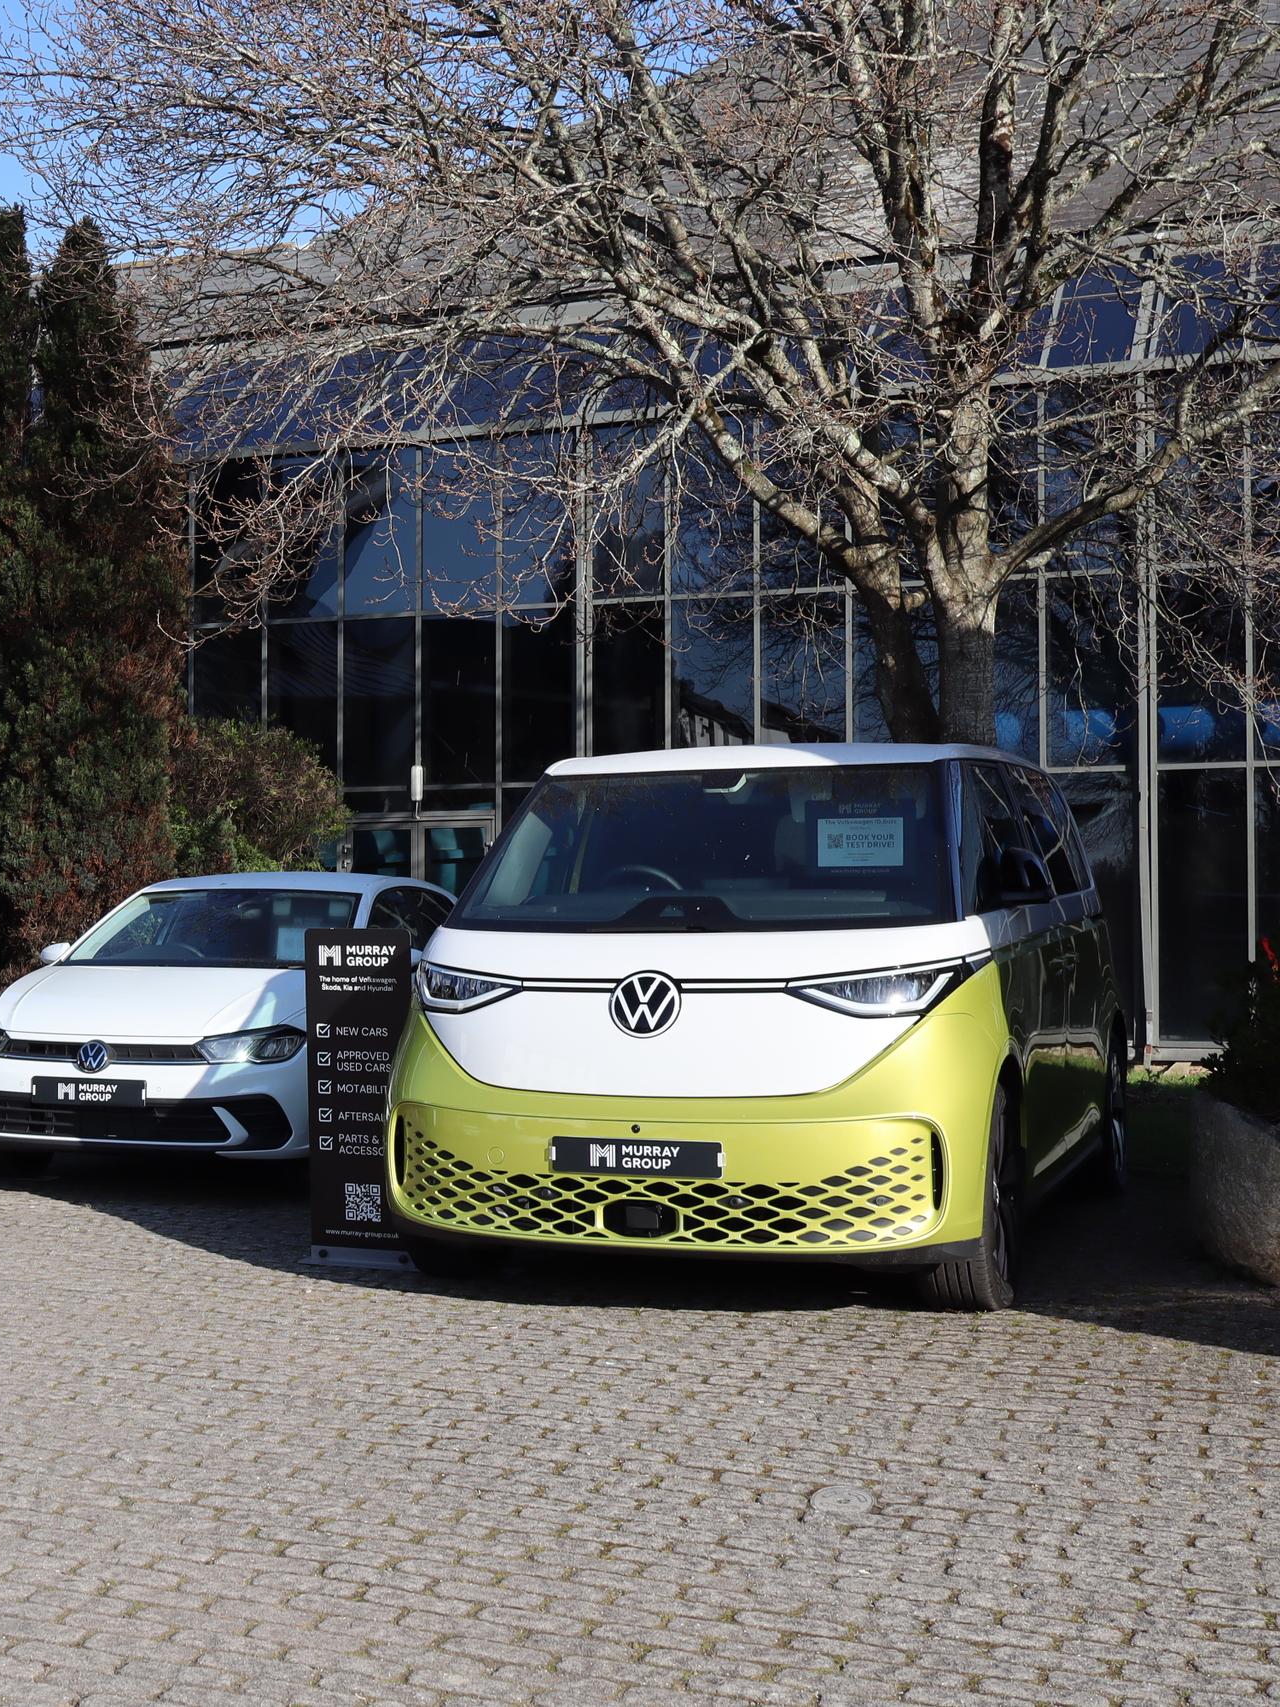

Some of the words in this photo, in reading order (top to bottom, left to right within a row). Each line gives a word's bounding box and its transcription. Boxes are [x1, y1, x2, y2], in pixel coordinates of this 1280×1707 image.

[846, 833, 869, 841] BOOK
[871, 833, 895, 841] YOUR
[346, 945, 396, 956] MURRAY
[346, 957, 389, 967] GROUP
[319, 975, 330, 983] The
[358, 976, 398, 984] Volkswagen,
[322, 983, 342, 991] Škoda,
[336, 1027, 359, 1036] NEW
[361, 1027, 388, 1037] CARS
[336, 1051, 390, 1061] APPROVED
[337, 1062, 362, 1072] USED
[365, 1063, 392, 1072] CARS
[79, 1084, 118, 1093] MURRAY
[337, 1084, 388, 1094] MOTABILIT
[78, 1093, 112, 1101] GROUP
[338, 1112, 384, 1122] AFTERSAL
[338, 1134, 370, 1144] PARTS
[371, 1135, 380, 1144] &
[338, 1146, 384, 1156] ACCESSO
[622, 1145, 680, 1158] MURRAY
[622, 1157, 672, 1170] GROUP
[326, 1229, 399, 1239] www.murray-group.co.uk
